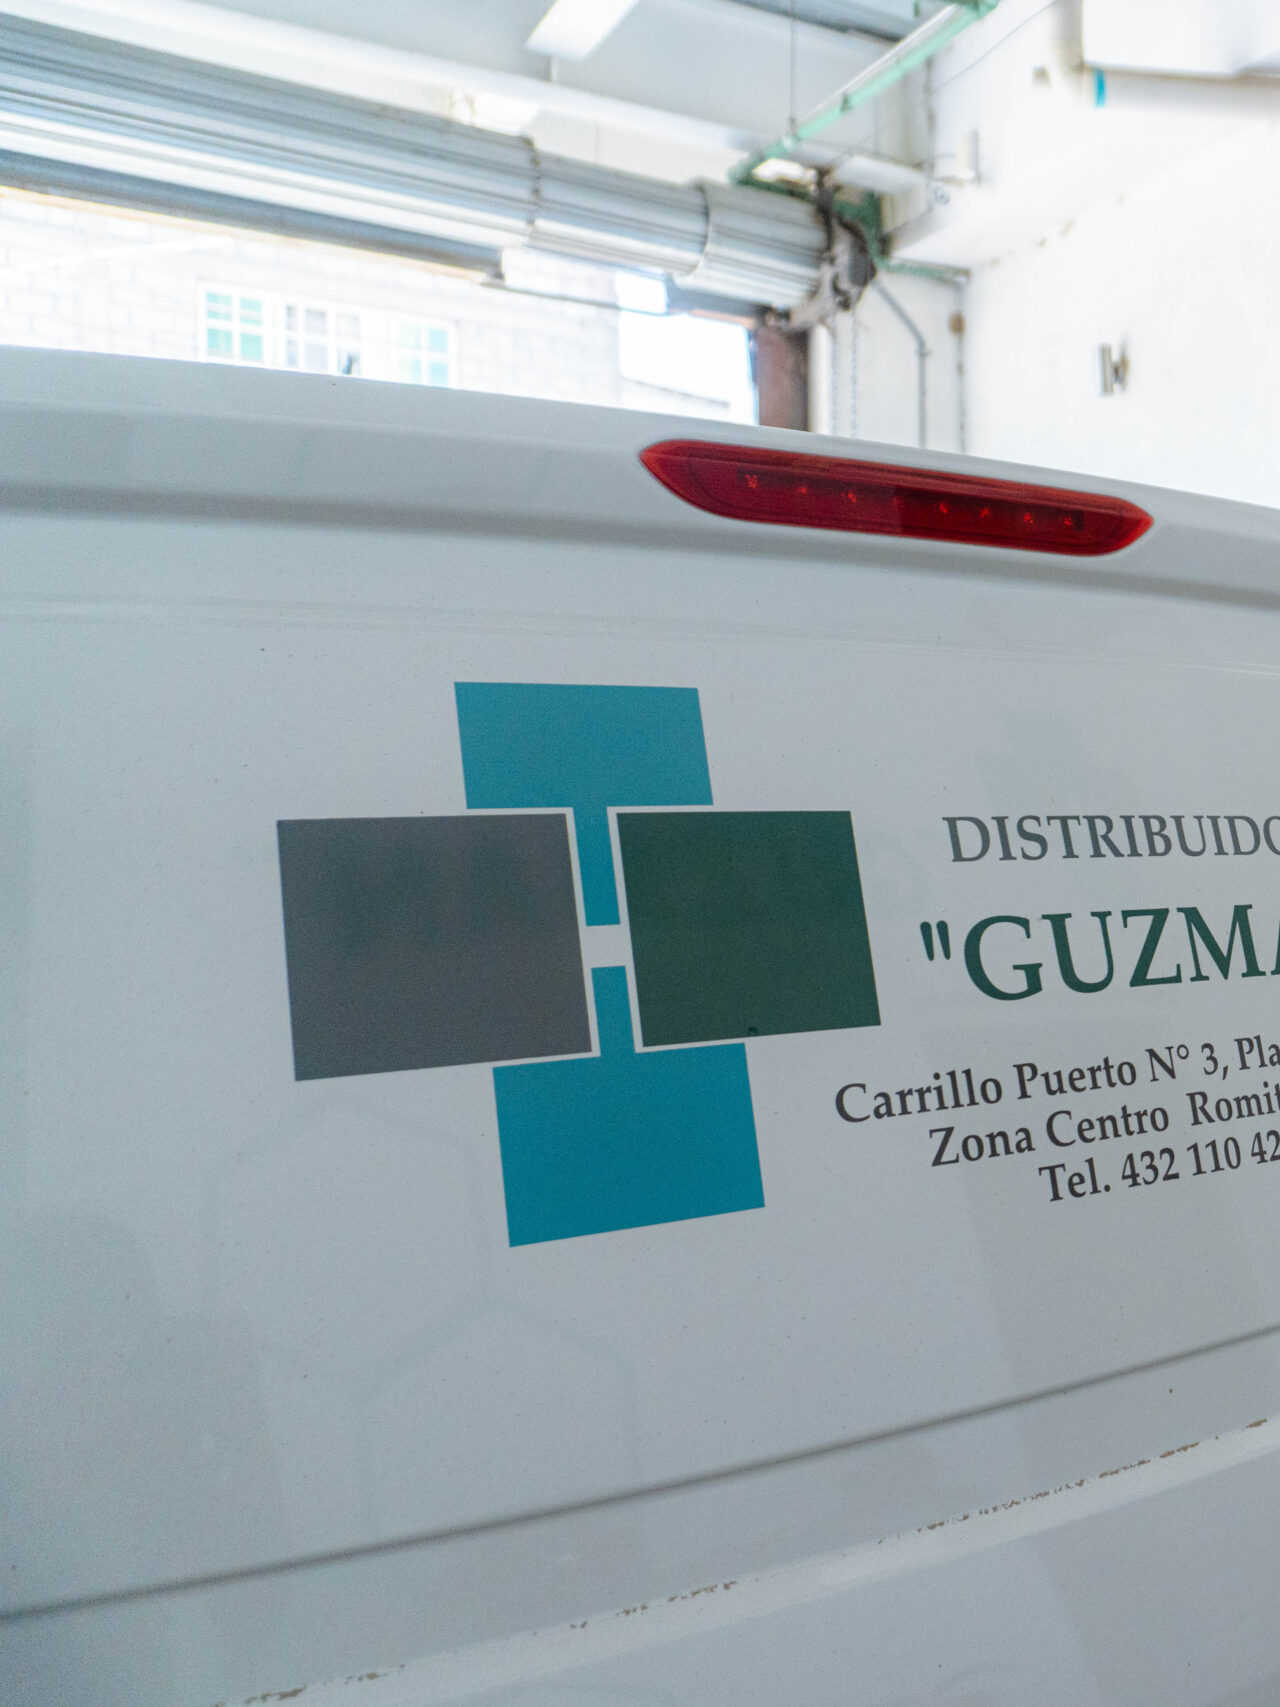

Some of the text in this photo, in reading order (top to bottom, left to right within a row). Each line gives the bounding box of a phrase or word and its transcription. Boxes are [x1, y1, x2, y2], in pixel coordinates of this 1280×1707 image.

[835, 1068, 1003, 1123] Carrillo
[1013, 1056, 1137, 1100] Puerto
[1201, 1043, 1229, 1081] 3,
[929, 1126, 1036, 1167] Zona
[1046, 1105, 1170, 1147] Centro
[1038, 1157, 1111, 1202] Tel.
[1122, 1148, 1180, 1188] 432
[1187, 1137, 1241, 1176] 110
